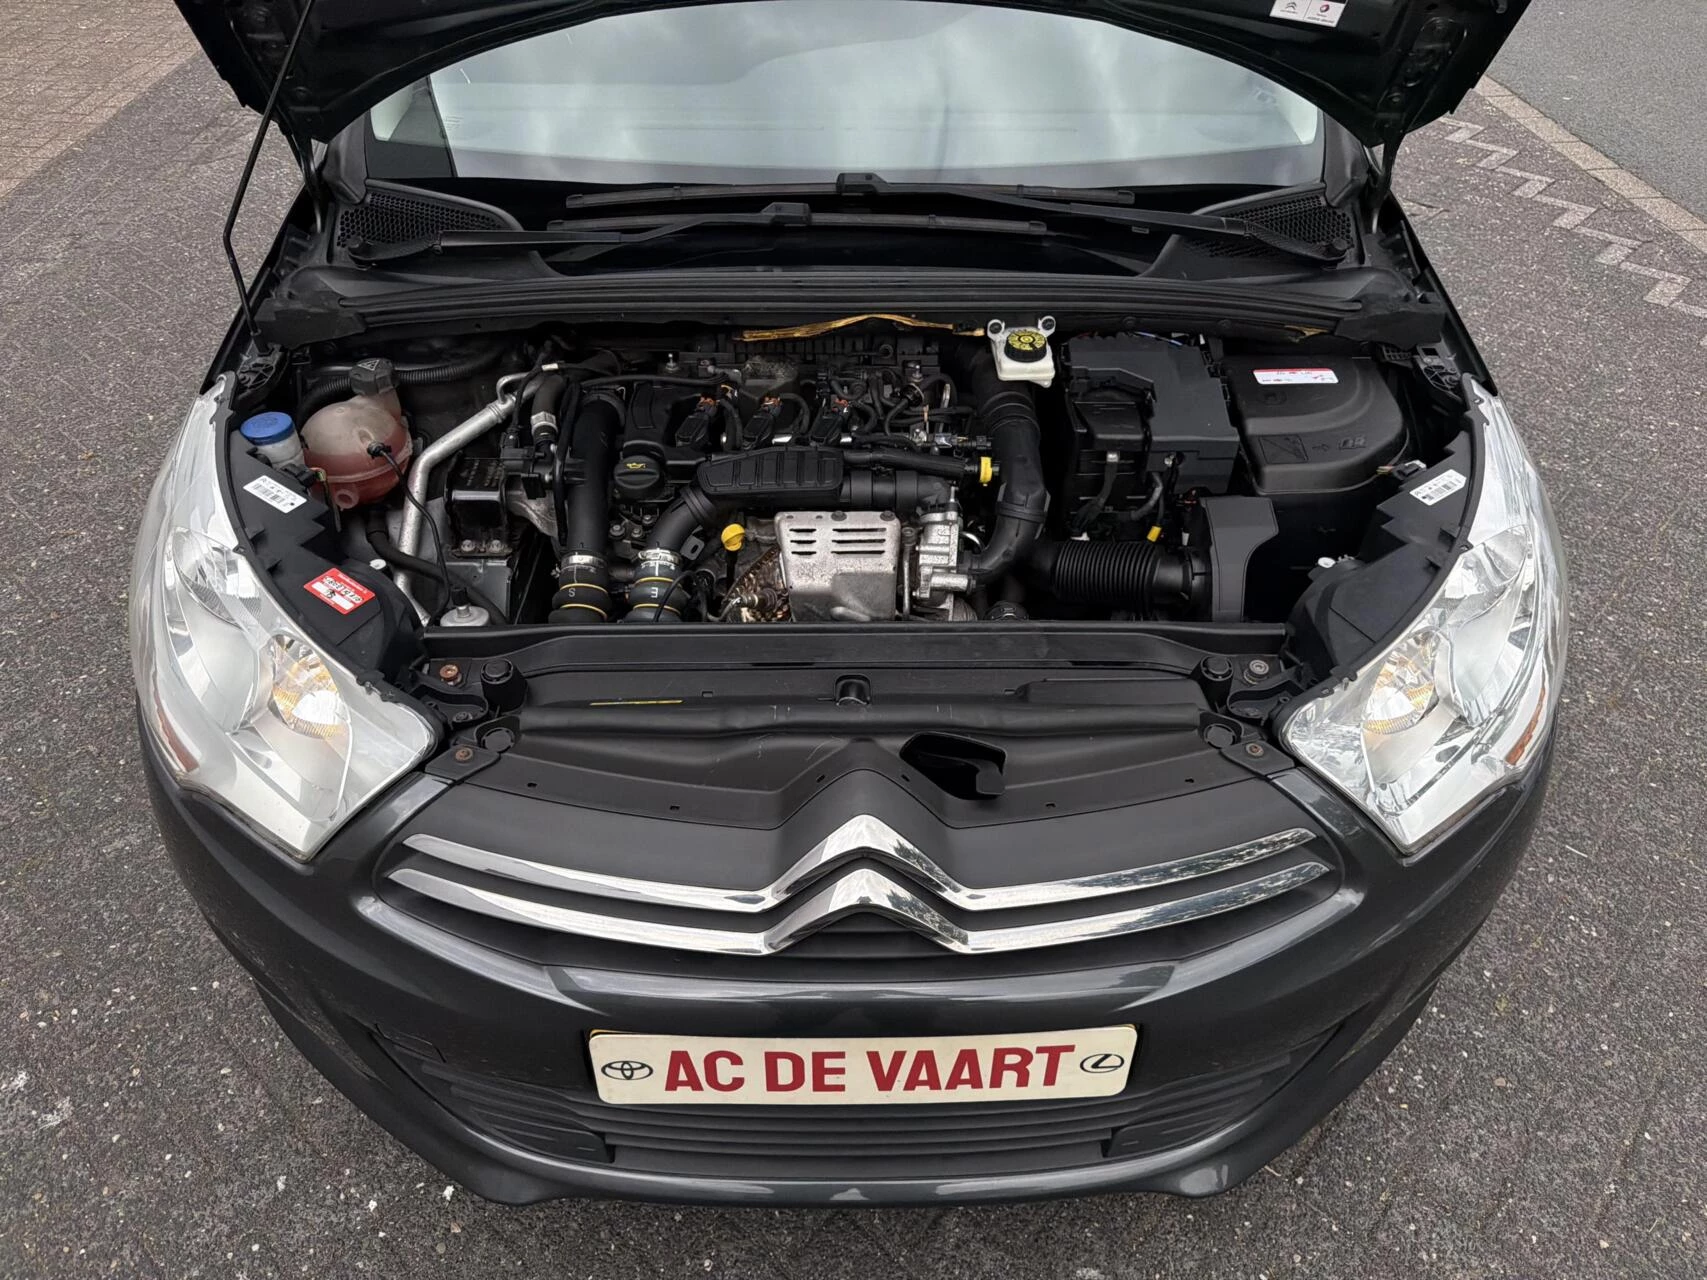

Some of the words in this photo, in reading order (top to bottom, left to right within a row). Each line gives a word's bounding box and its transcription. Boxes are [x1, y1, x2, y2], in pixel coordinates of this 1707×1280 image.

[664, 1050, 745, 1093] AC
[763, 1050, 847, 1094] DE
[866, 1044, 1076, 1093] VAART
